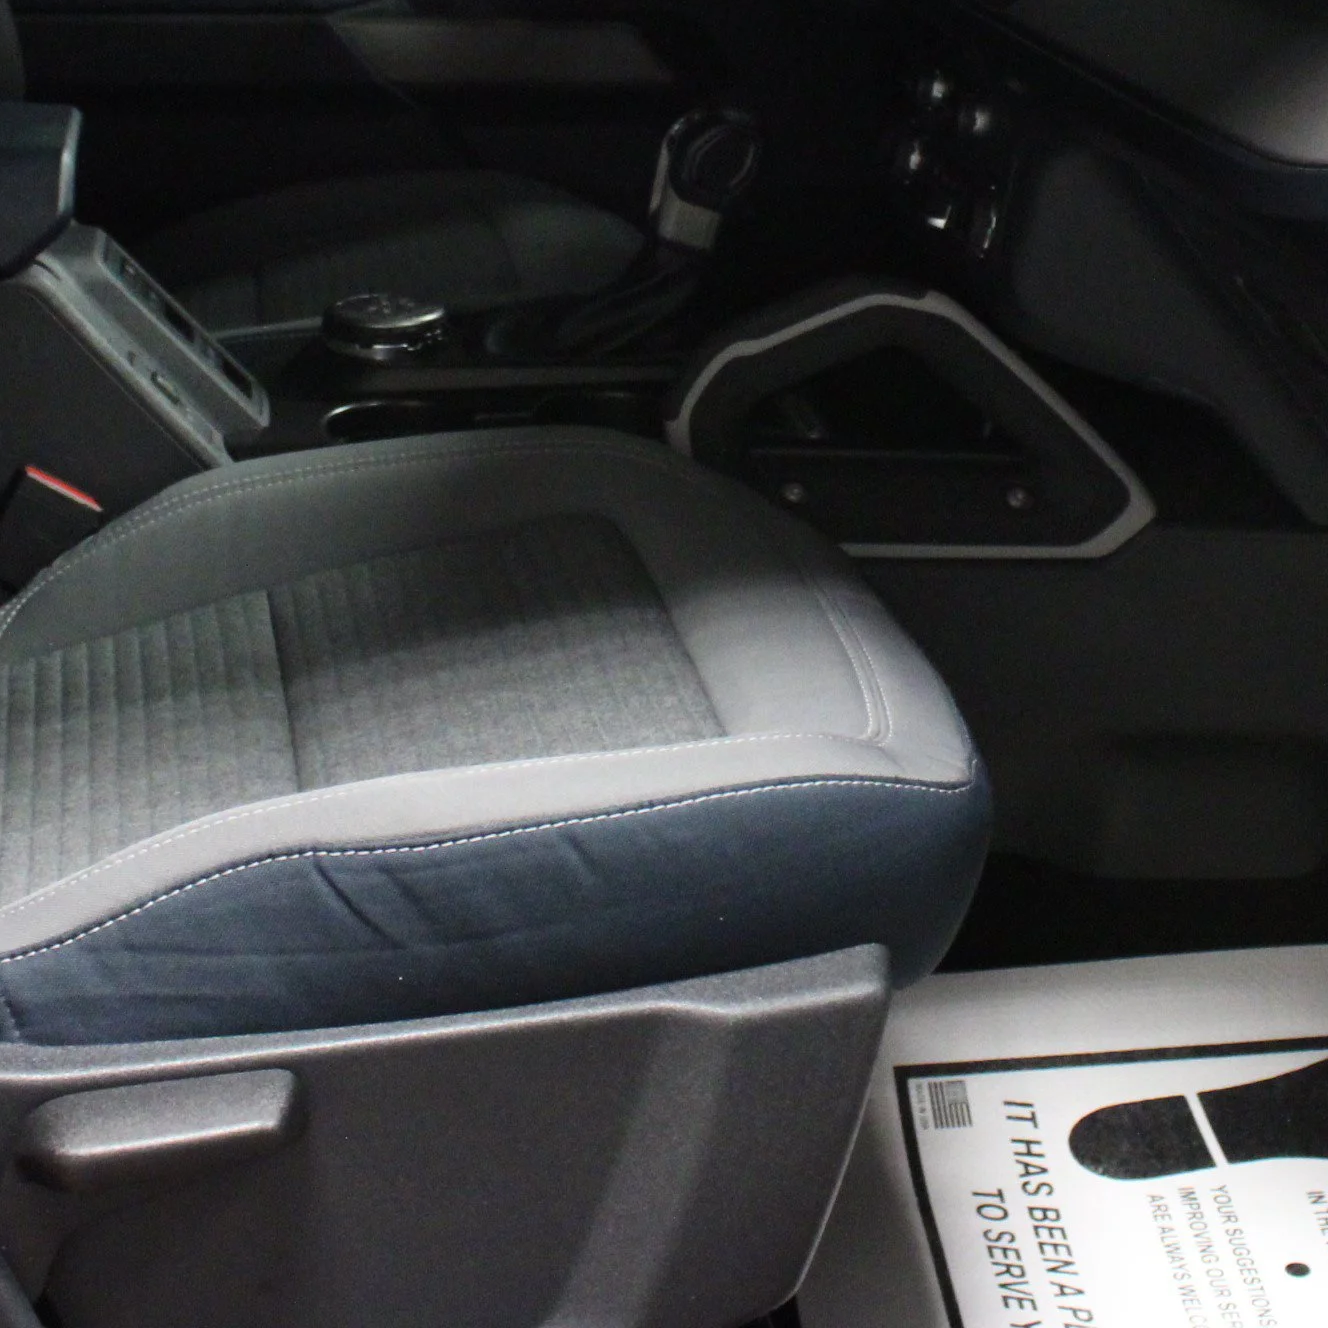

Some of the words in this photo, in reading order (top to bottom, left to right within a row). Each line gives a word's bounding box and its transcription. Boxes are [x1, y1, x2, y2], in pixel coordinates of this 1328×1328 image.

[1003, 1099, 1039, 1129] IT
[1010, 1138, 1054, 1197] HAS
[972, 1187, 1010, 1222] TO
[1146, 1193, 1172, 1223] ARE
[1306, 1190, 1328, 1206] IN
[983, 1227, 1038, 1312] SERVE
[1027, 1205, 1079, 1276] BEEN
[1157, 1224, 1193, 1282] ALWAYS
[1177, 1186, 1220, 1264] IMPROVING
[1205, 1267, 1232, 1298] OUR
[1209, 1184, 1239, 1224] YOUR
[1225, 1227, 1278, 1328] SUGGESTIONS
[1049, 1280, 1085, 1298] A
